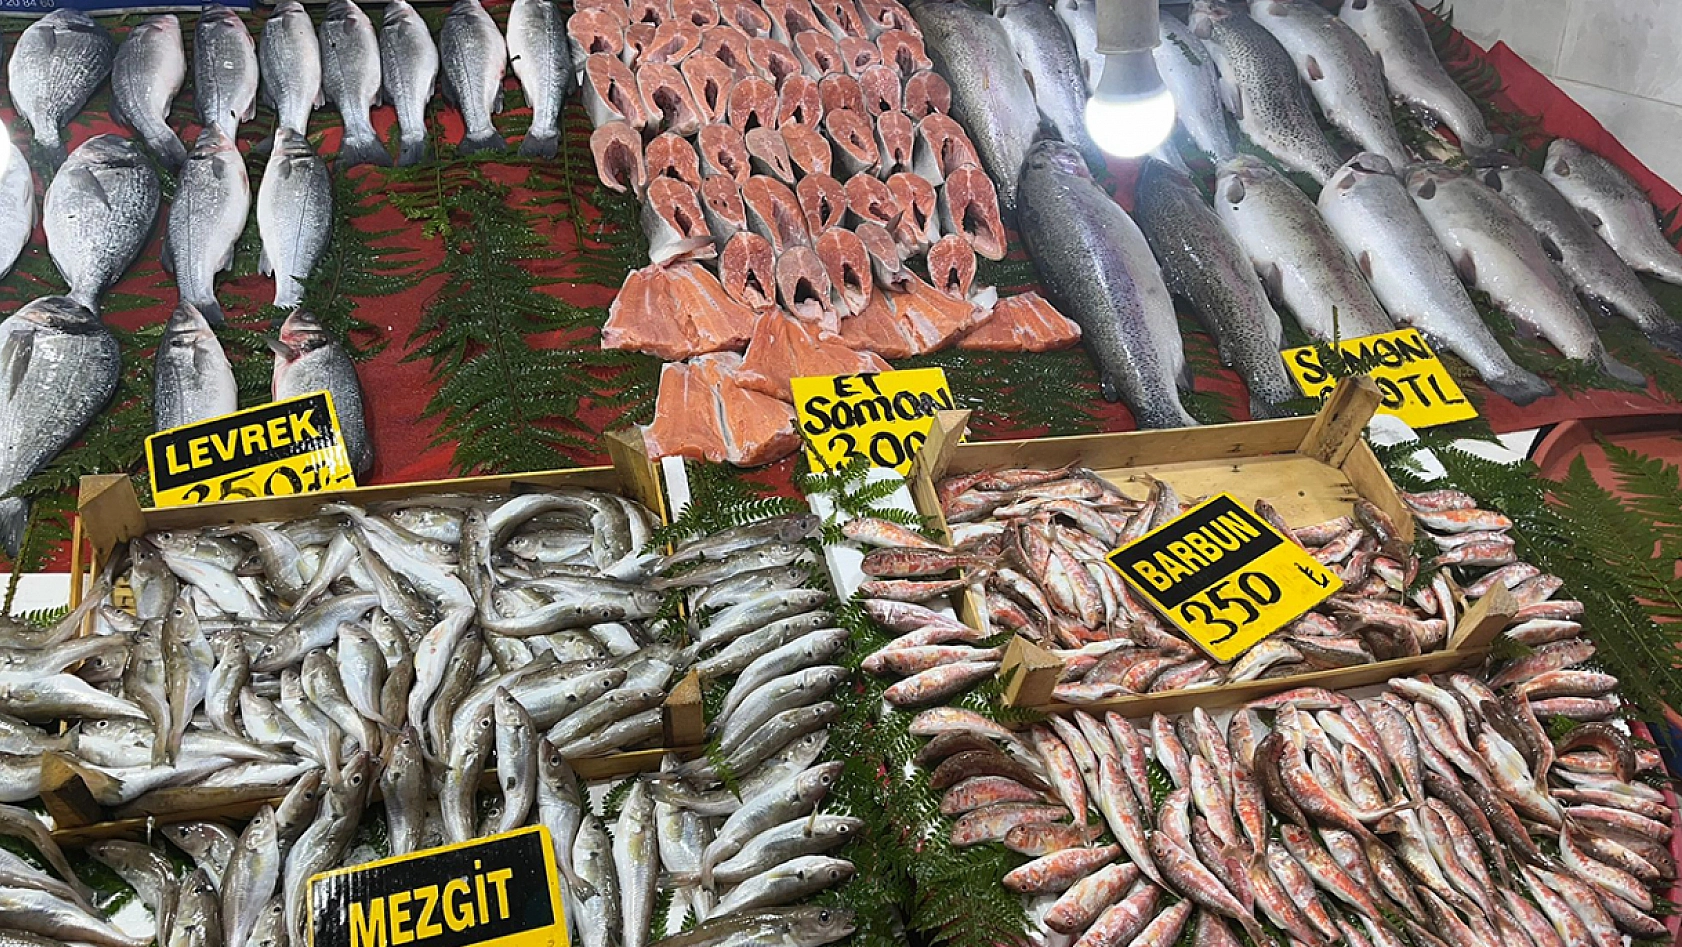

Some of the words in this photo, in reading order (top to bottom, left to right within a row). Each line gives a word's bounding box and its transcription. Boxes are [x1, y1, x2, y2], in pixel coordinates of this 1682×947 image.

[832, 373, 883, 398] ET
[1295, 334, 1430, 383] SMON
[166, 409, 322, 476] LEVREK
[1132, 510, 1262, 592] BARBUN
[1180, 572, 1283, 645] 350
[349, 859, 514, 947] MEZGİT
